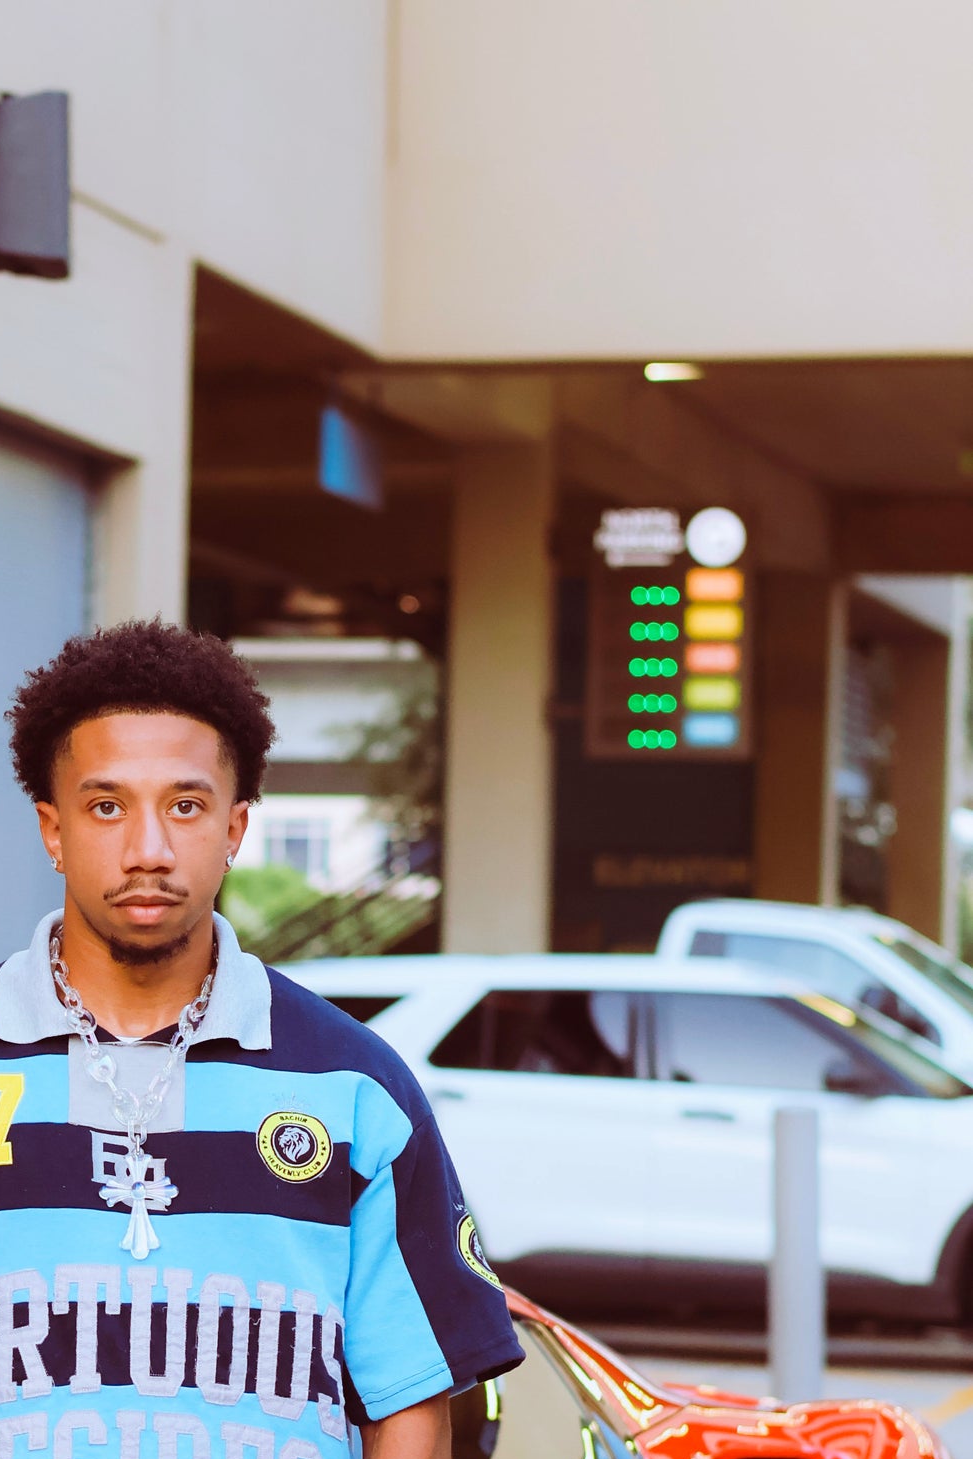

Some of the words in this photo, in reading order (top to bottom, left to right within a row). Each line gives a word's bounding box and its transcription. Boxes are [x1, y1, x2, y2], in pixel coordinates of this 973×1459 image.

[279, 1115, 308, 1123] BACHIR
[267, 1155, 301, 1177] HEAVENLY
[303, 1161, 322, 1175] CLUB
